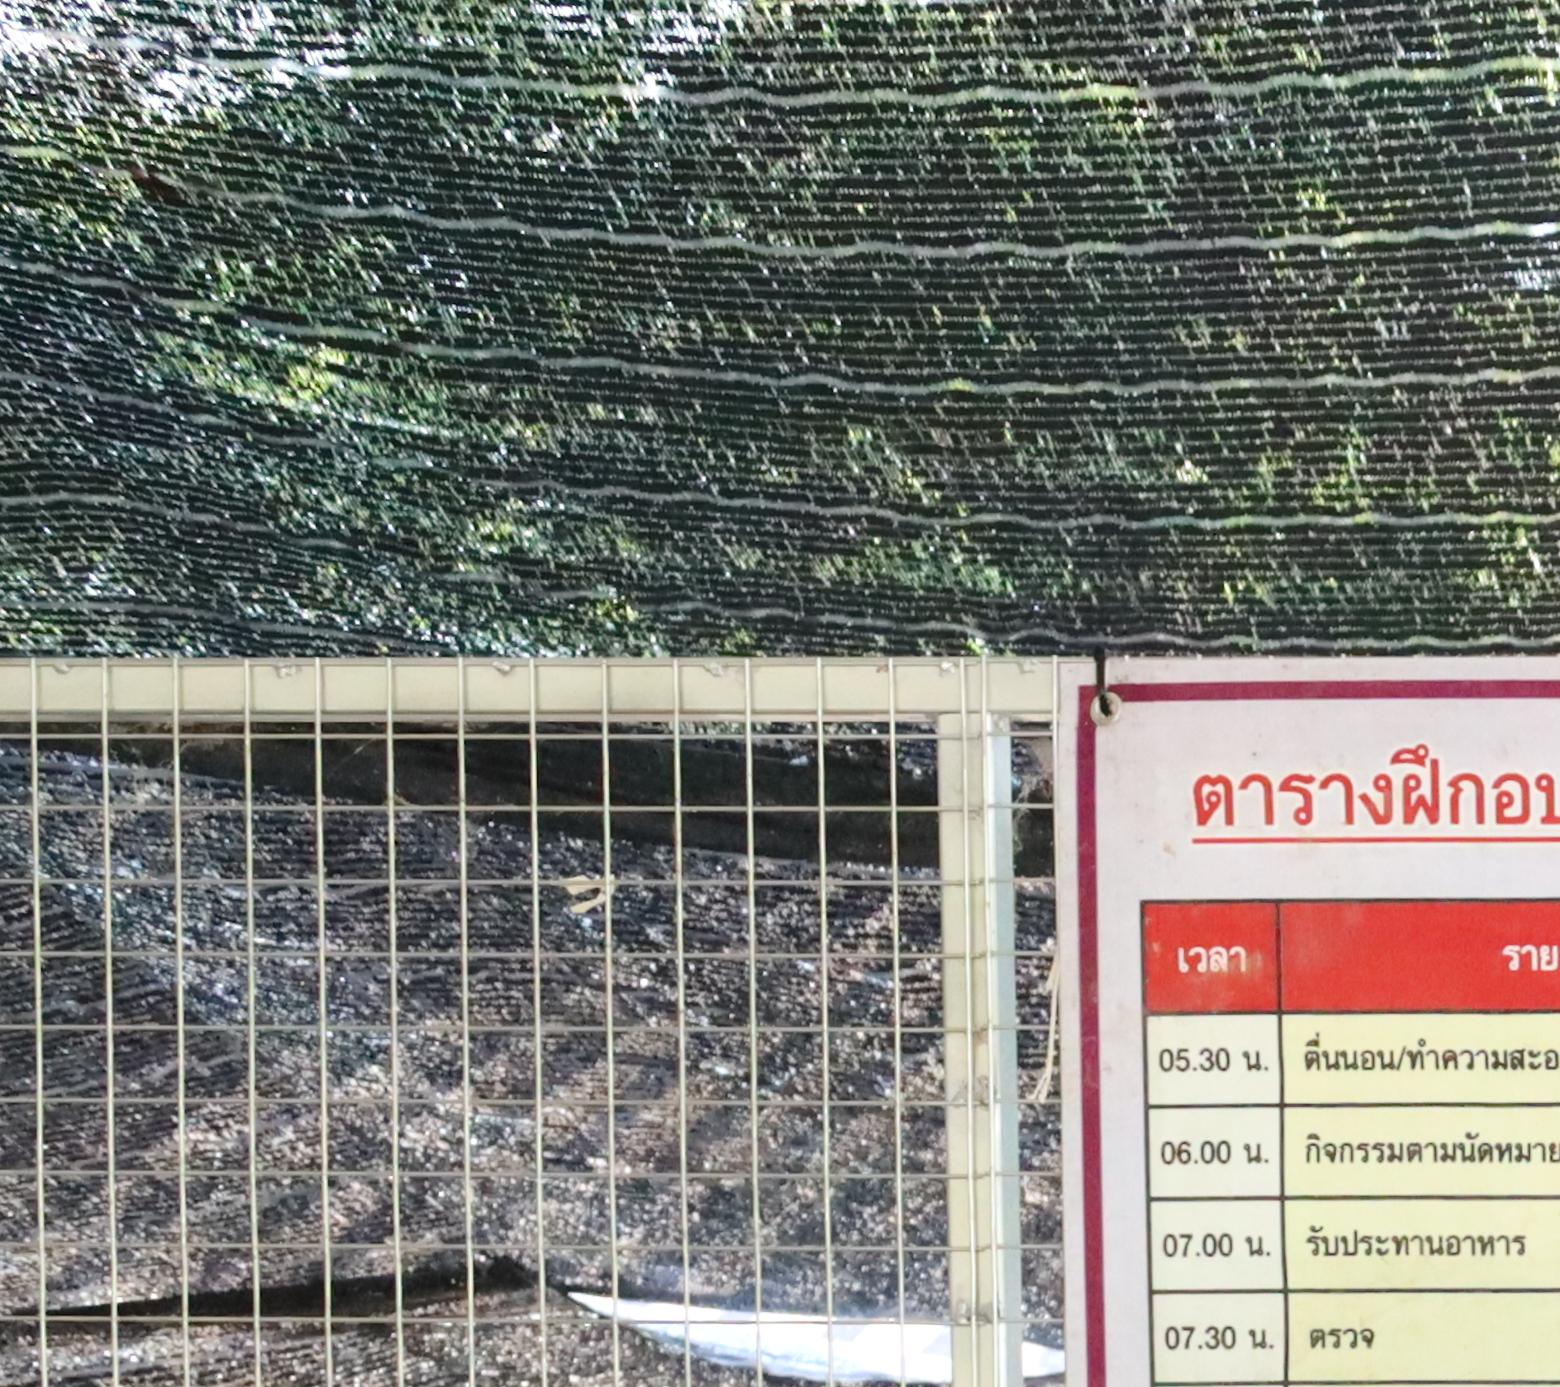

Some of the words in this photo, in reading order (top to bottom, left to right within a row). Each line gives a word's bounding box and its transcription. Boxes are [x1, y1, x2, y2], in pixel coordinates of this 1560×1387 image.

[1177, 945, 1248, 974] เวลา
[1158, 1047, 1231, 1073] 05.30
[1241, 1050, 1269, 1072] น.
[1160, 1139, 1232, 1166] 06.00
[1242, 1143, 1269, 1165] น.
[1162, 1232, 1234, 1258] 07.00
[1244, 1235, 1271, 1257] น.
[1305, 1225, 1527, 1257] รับประทานอาหาร
[1164, 1325, 1237, 1351] 07.30
[1248, 1328, 1275, 1350] น.
[1309, 1327, 1375, 1350] ตรวจ
